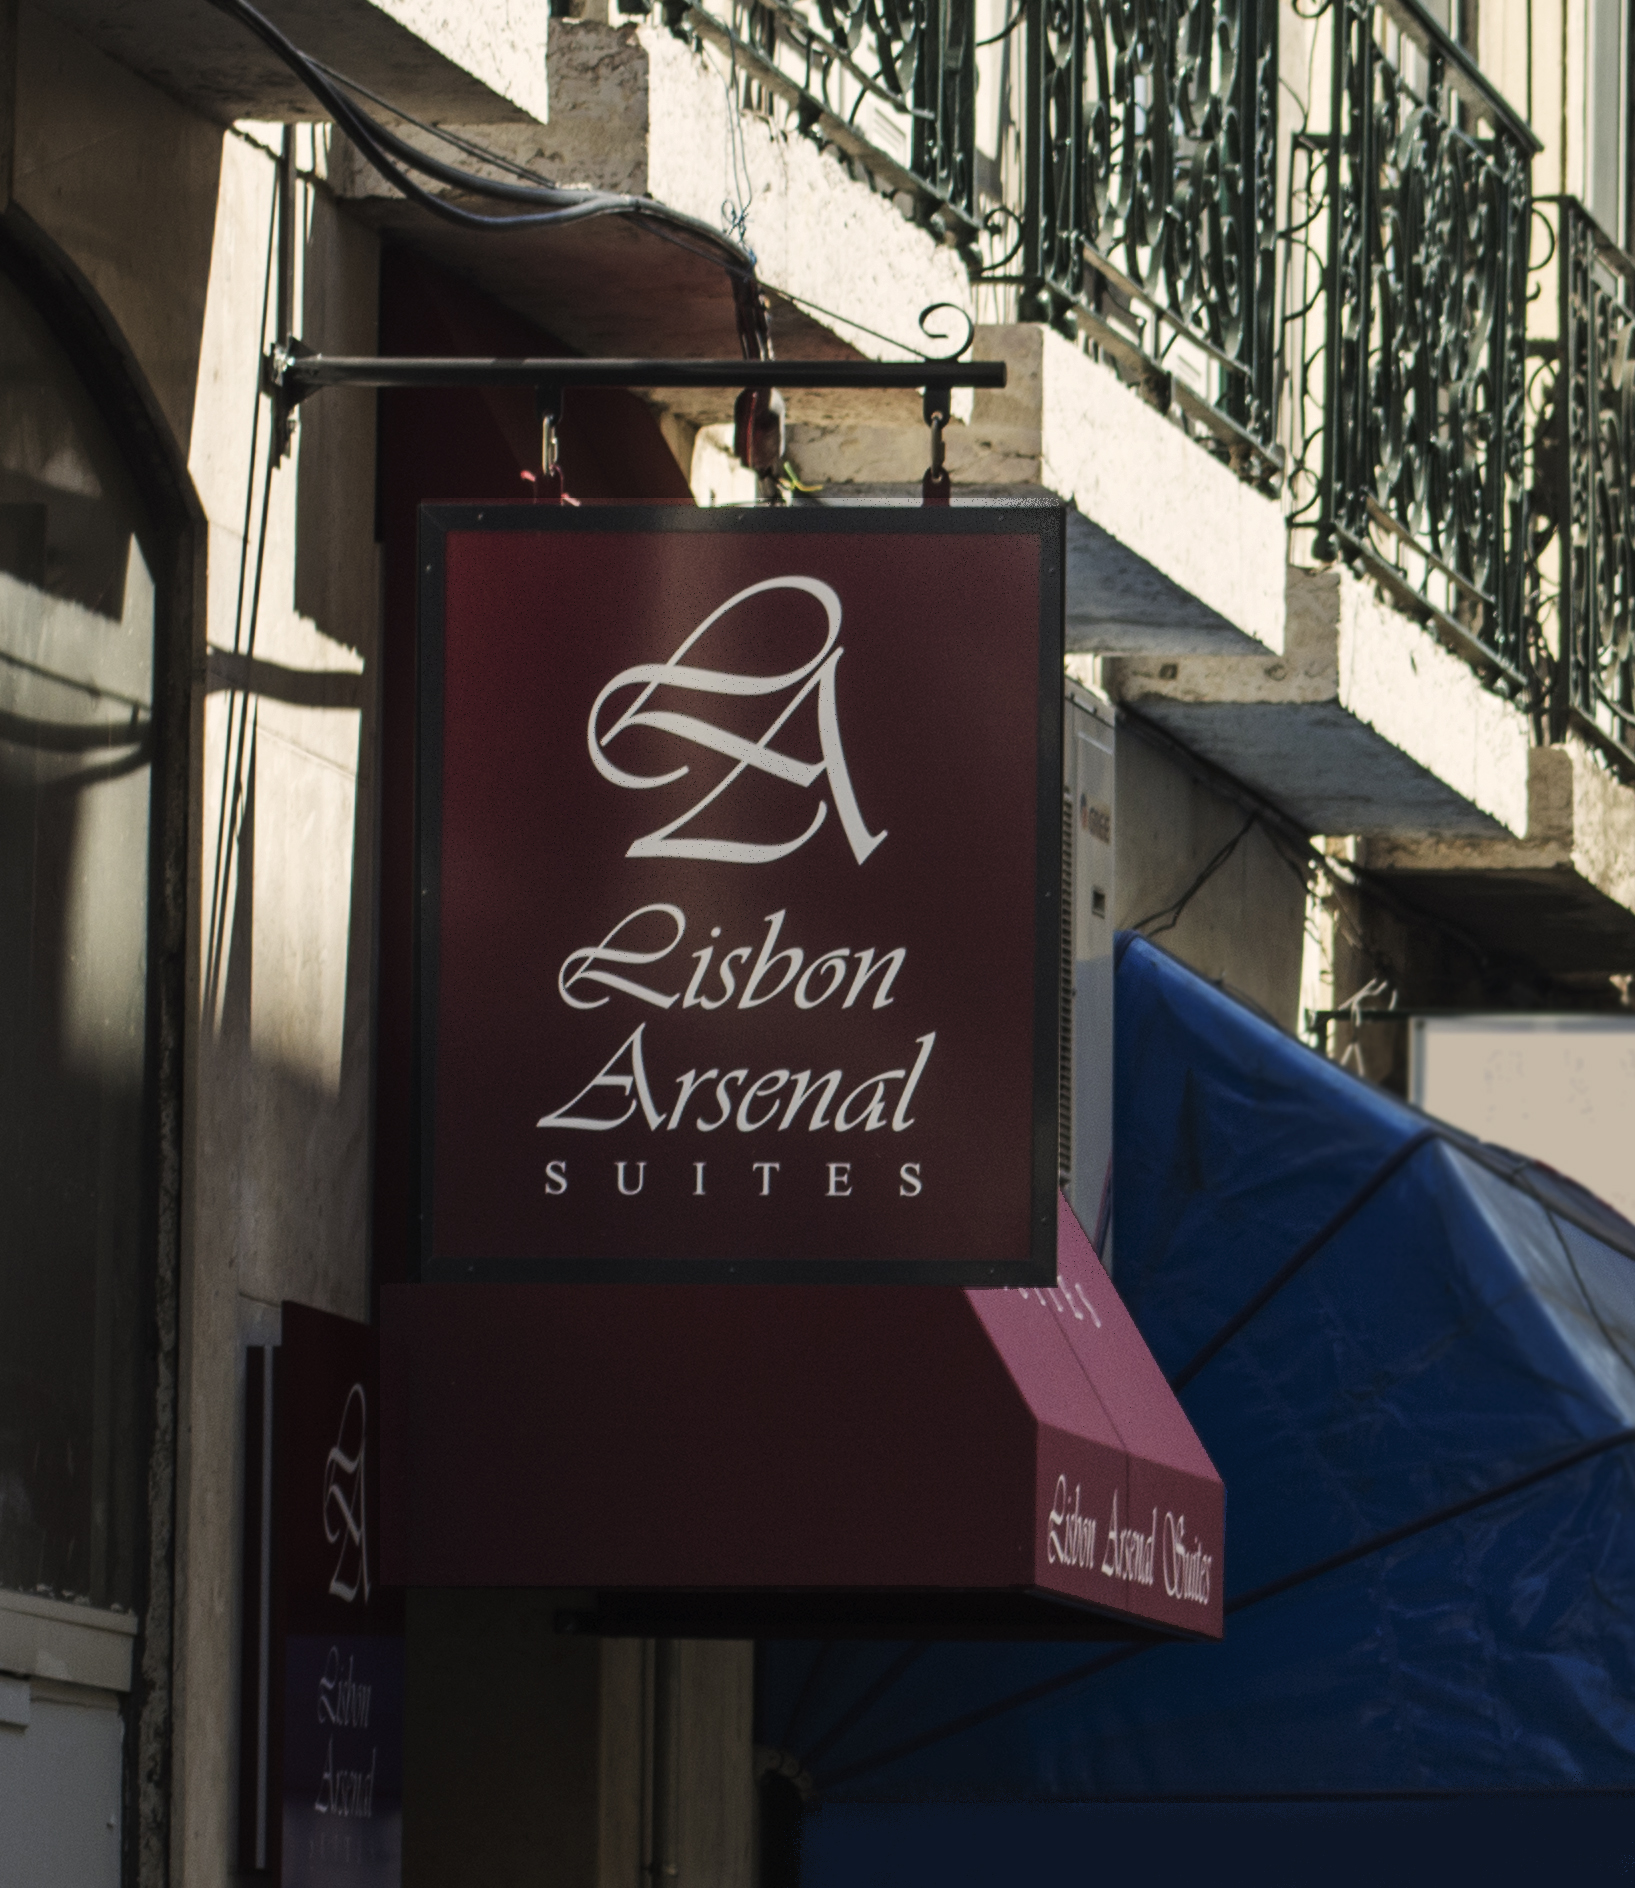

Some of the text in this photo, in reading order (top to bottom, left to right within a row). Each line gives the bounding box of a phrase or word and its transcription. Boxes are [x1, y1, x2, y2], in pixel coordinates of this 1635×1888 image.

[558, 903, 907, 1011] Lisbon
[536, 1022, 937, 1133] Arsenal
[544, 1159, 923, 1198] SUITES
[1047, 1472, 1097, 1571] Lisbon
[1101, 1487, 1158, 1587] Arsenal
[317, 1644, 372, 1729] Lisbon
[314, 1732, 377, 1819] Arsenal
